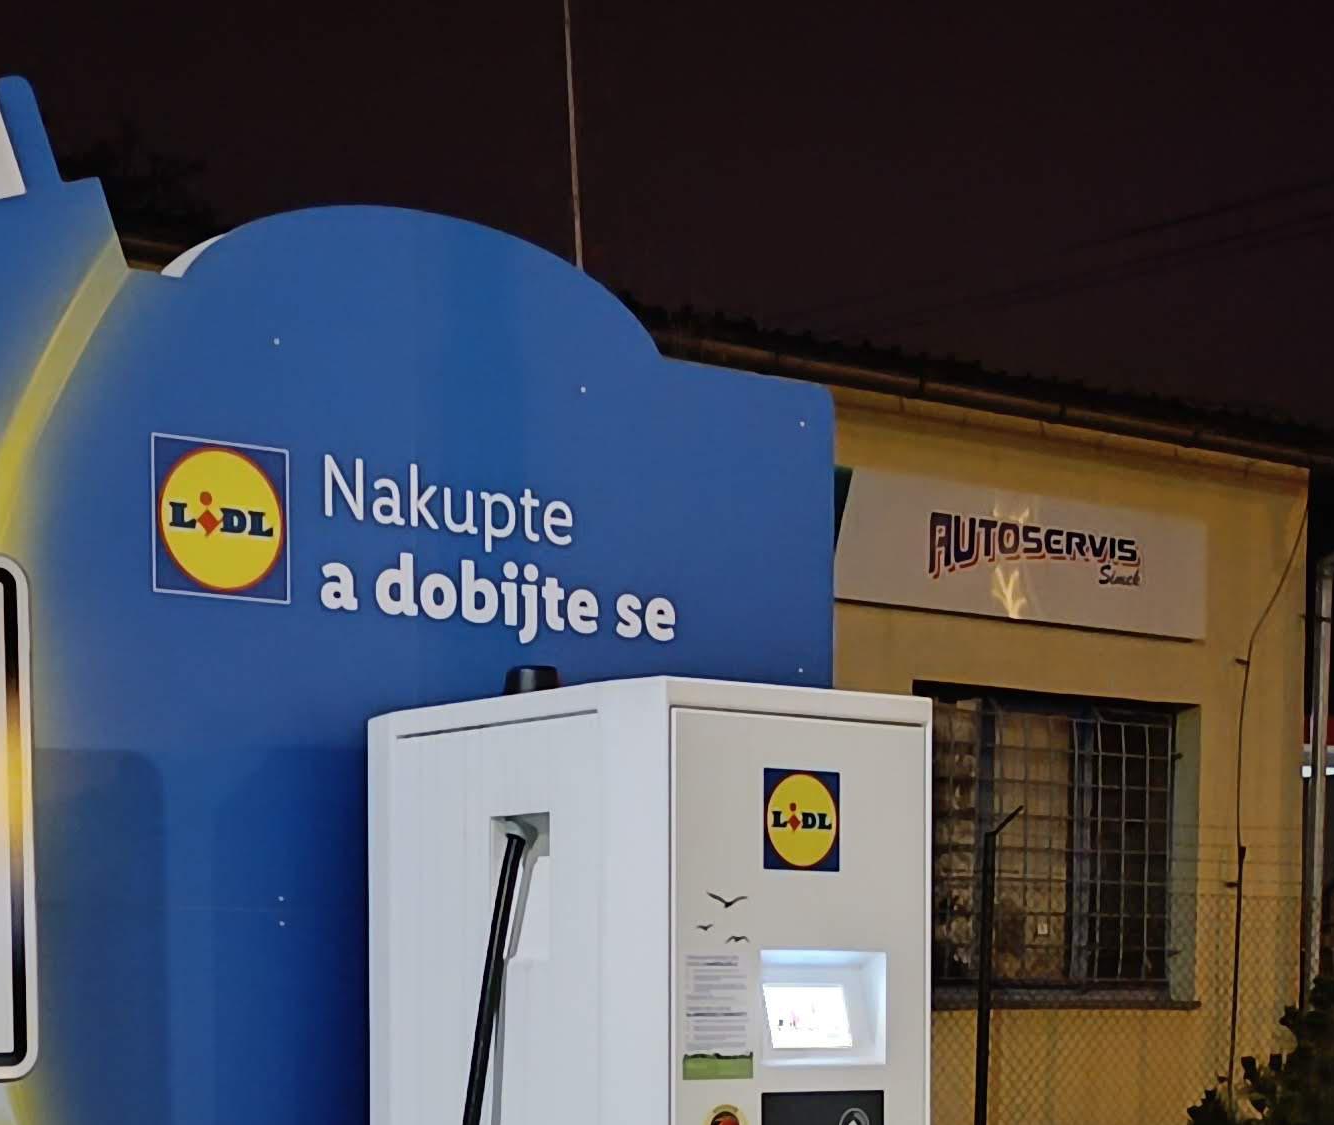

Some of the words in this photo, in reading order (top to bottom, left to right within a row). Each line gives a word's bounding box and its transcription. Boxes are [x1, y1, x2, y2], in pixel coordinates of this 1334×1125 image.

[324, 454, 573, 552] Nakupte
[928, 511, 1141, 579] AUTOSERVIS
[320, 562, 358, 610] a
[376, 552, 599, 644] dobijte
[615, 593, 676, 641] se
